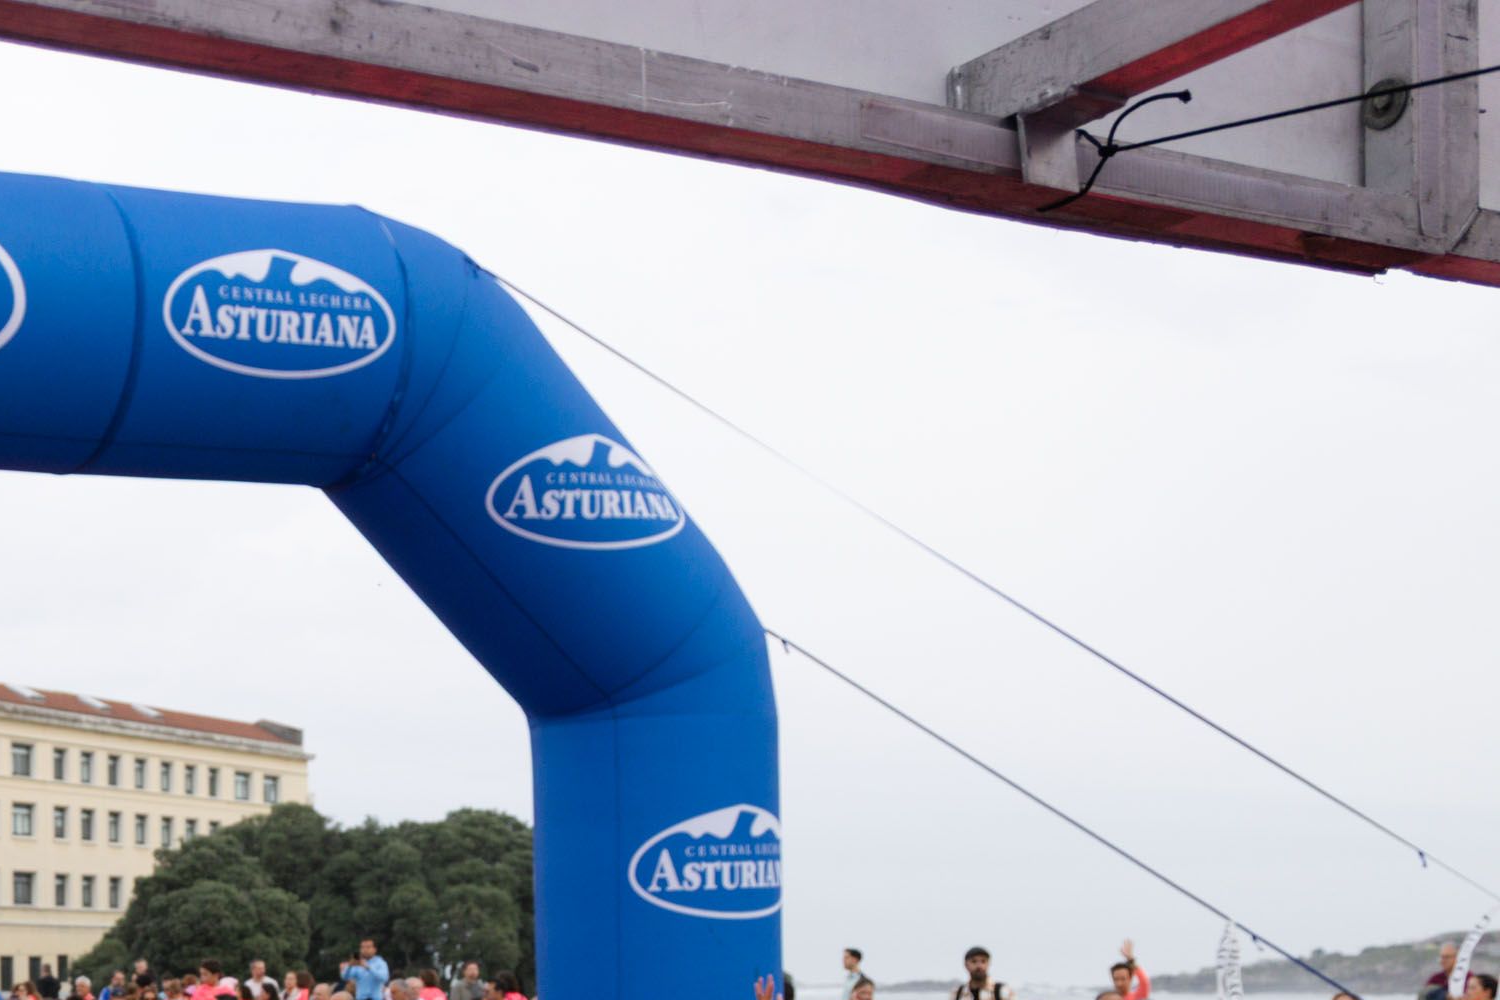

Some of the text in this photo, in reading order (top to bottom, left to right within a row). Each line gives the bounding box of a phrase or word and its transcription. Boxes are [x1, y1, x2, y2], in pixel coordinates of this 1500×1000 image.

[218, 285, 372, 310] CENTRAL LECHERA
[181, 284, 378, 349] ASTURIANA
[546, 472, 612, 484] CENTRAL
[503, 474, 679, 521] ASTURIANA
[684, 844, 752, 857] CENTRAL
